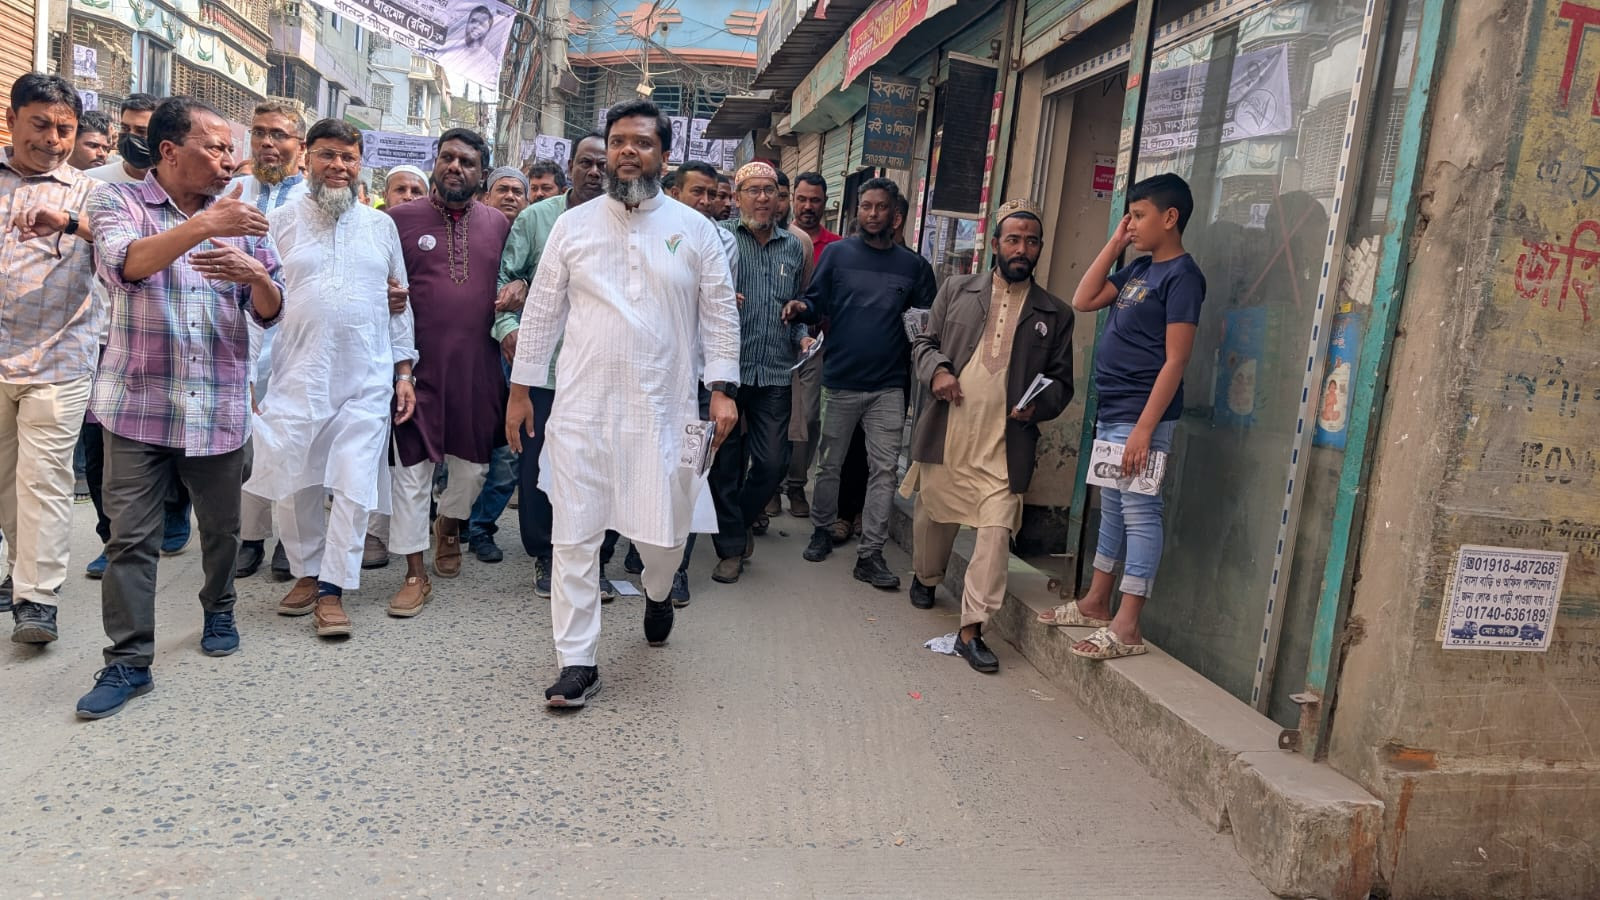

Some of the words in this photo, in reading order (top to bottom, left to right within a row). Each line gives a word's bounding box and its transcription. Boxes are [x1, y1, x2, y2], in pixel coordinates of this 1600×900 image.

[872, 76, 917, 100] ইকবাল
[868, 117, 883, 134] বই
[885, 123, 892, 134] ও
[893, 120, 913, 137] শিক্ষা
[1475, 557, 1555, 575] 01918-487268
[1464, 576, 1478, 587] বাসা
[1479, 573, 1494, 589] বাড়ি
[1496, 579, 1501, 587] ও
[1503, 574, 1522, 587] অফিস
[1462, 591, 1474, 602] জন্য
[1475, 592, 1491, 603] লোক
[1493, 594, 1498, 603] ও
[1515, 594, 1532, 606] পাওয়া
[1465, 606, 1546, 622] 01740-636189
[1481, 628, 1496, 636] মোঃ
[1497, 625, 1516, 636] কবির
